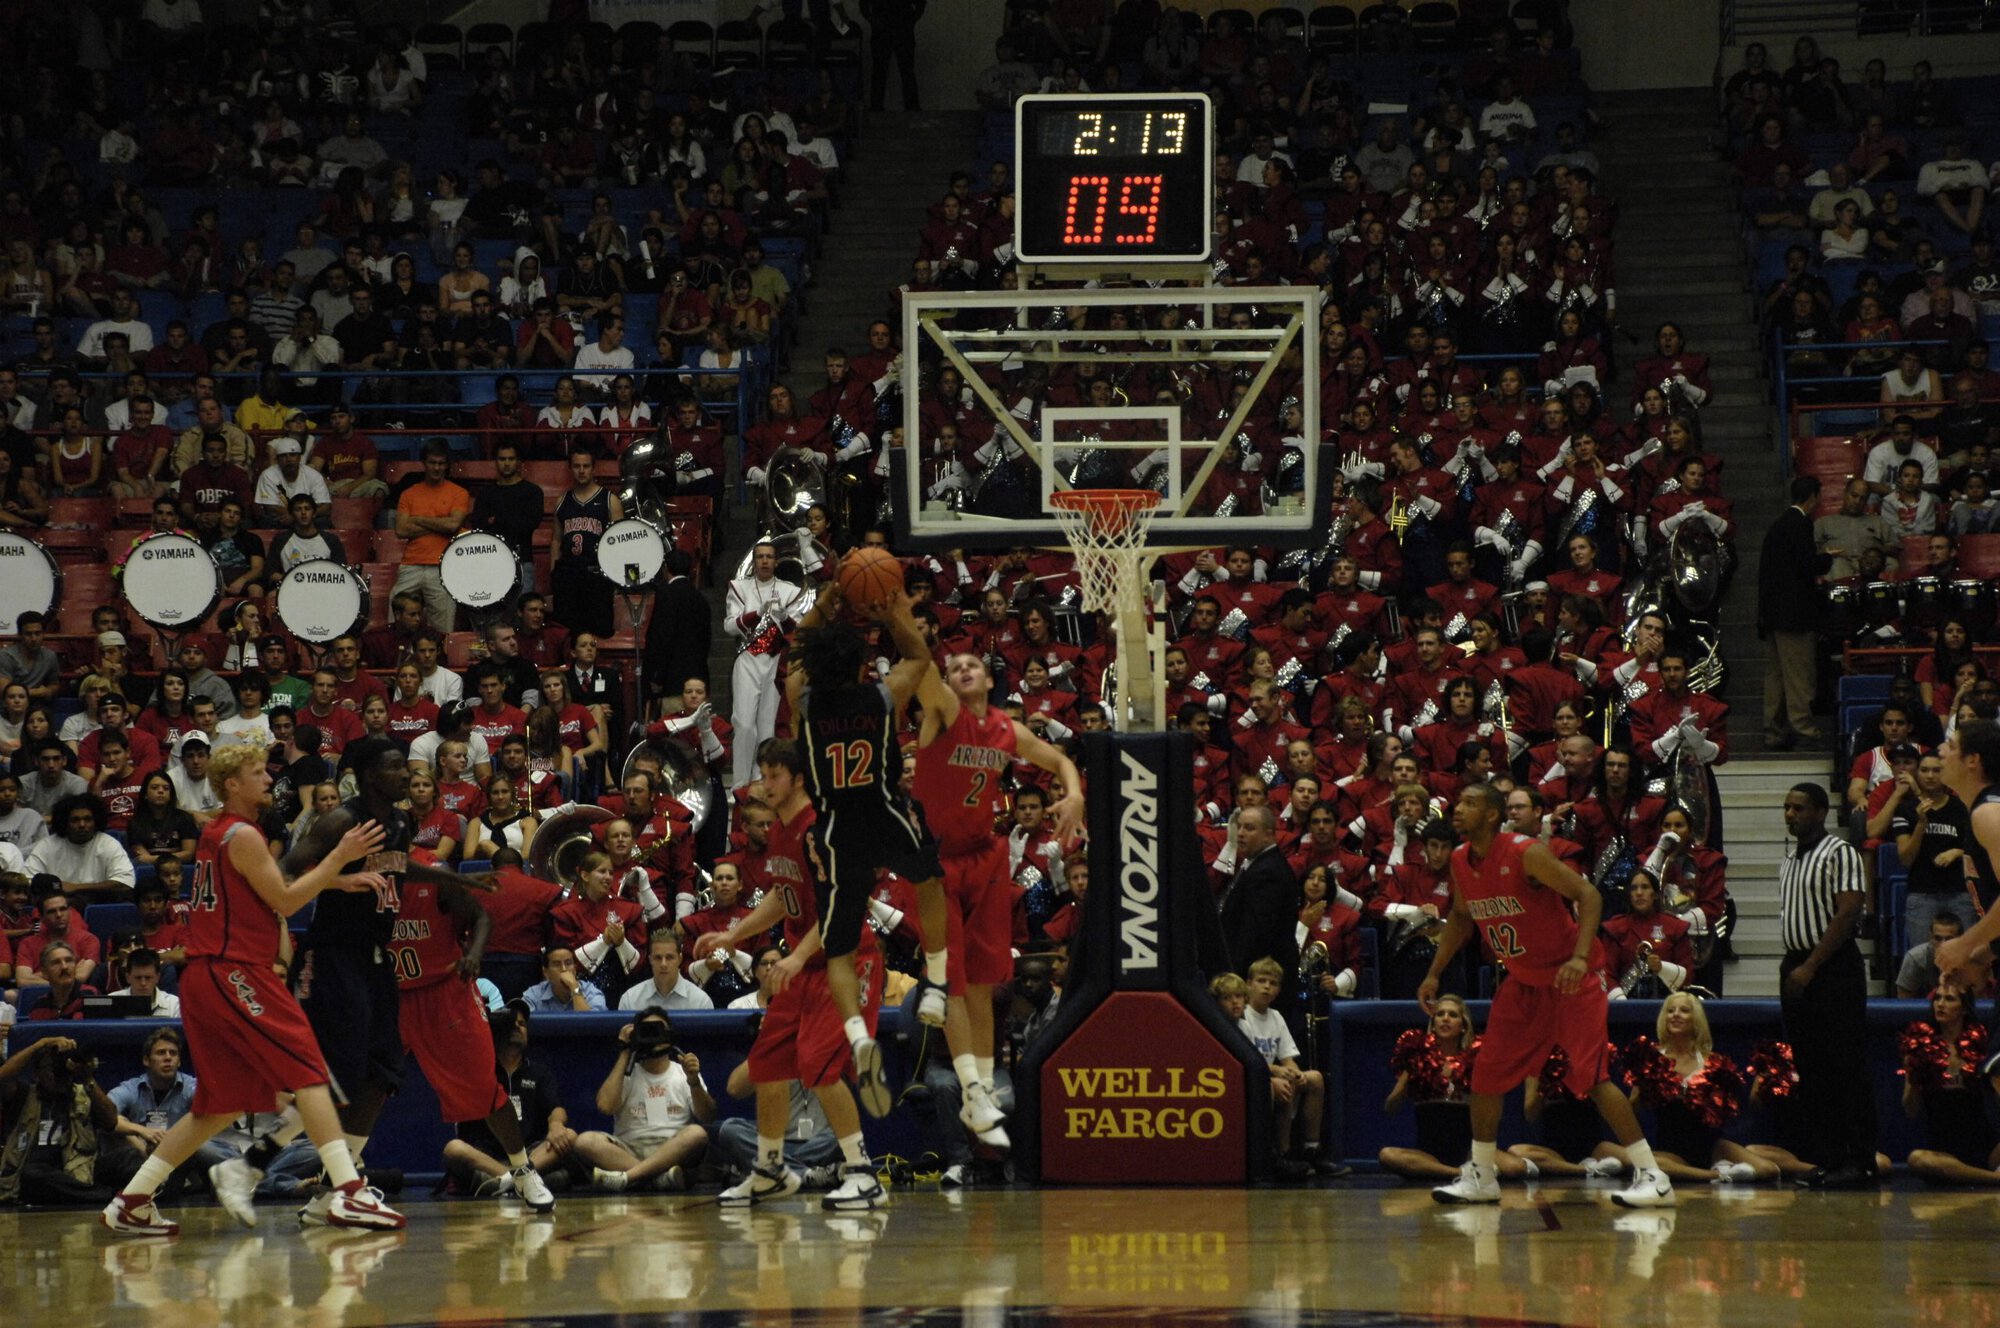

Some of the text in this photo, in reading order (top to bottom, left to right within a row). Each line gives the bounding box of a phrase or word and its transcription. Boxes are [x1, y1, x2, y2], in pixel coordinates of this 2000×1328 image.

[1074, 113, 1187, 154] 2:13
[1063, 176, 1163, 244] 09
[465, 544, 498, 556] YAMAHA
[571, 533, 584, 556] 3
[616, 529, 650, 544] YAMAHA
[154, 547, 196, 560] YAMAHA
[306, 572, 346, 584] YAMAHA
[818, 714, 880, 736] DILLON
[825, 738, 874, 789] 12
[948, 744, 1009, 773] ARIZON
[964, 770, 986, 807] 2
[1119, 749, 1158, 974] ARIZONA
[1487, 923, 1527, 958] 42
[386, 947, 422, 980] 20
[1056, 1068, 1227, 1100] WELLS
[1063, 1108, 1225, 1139] FARGO
